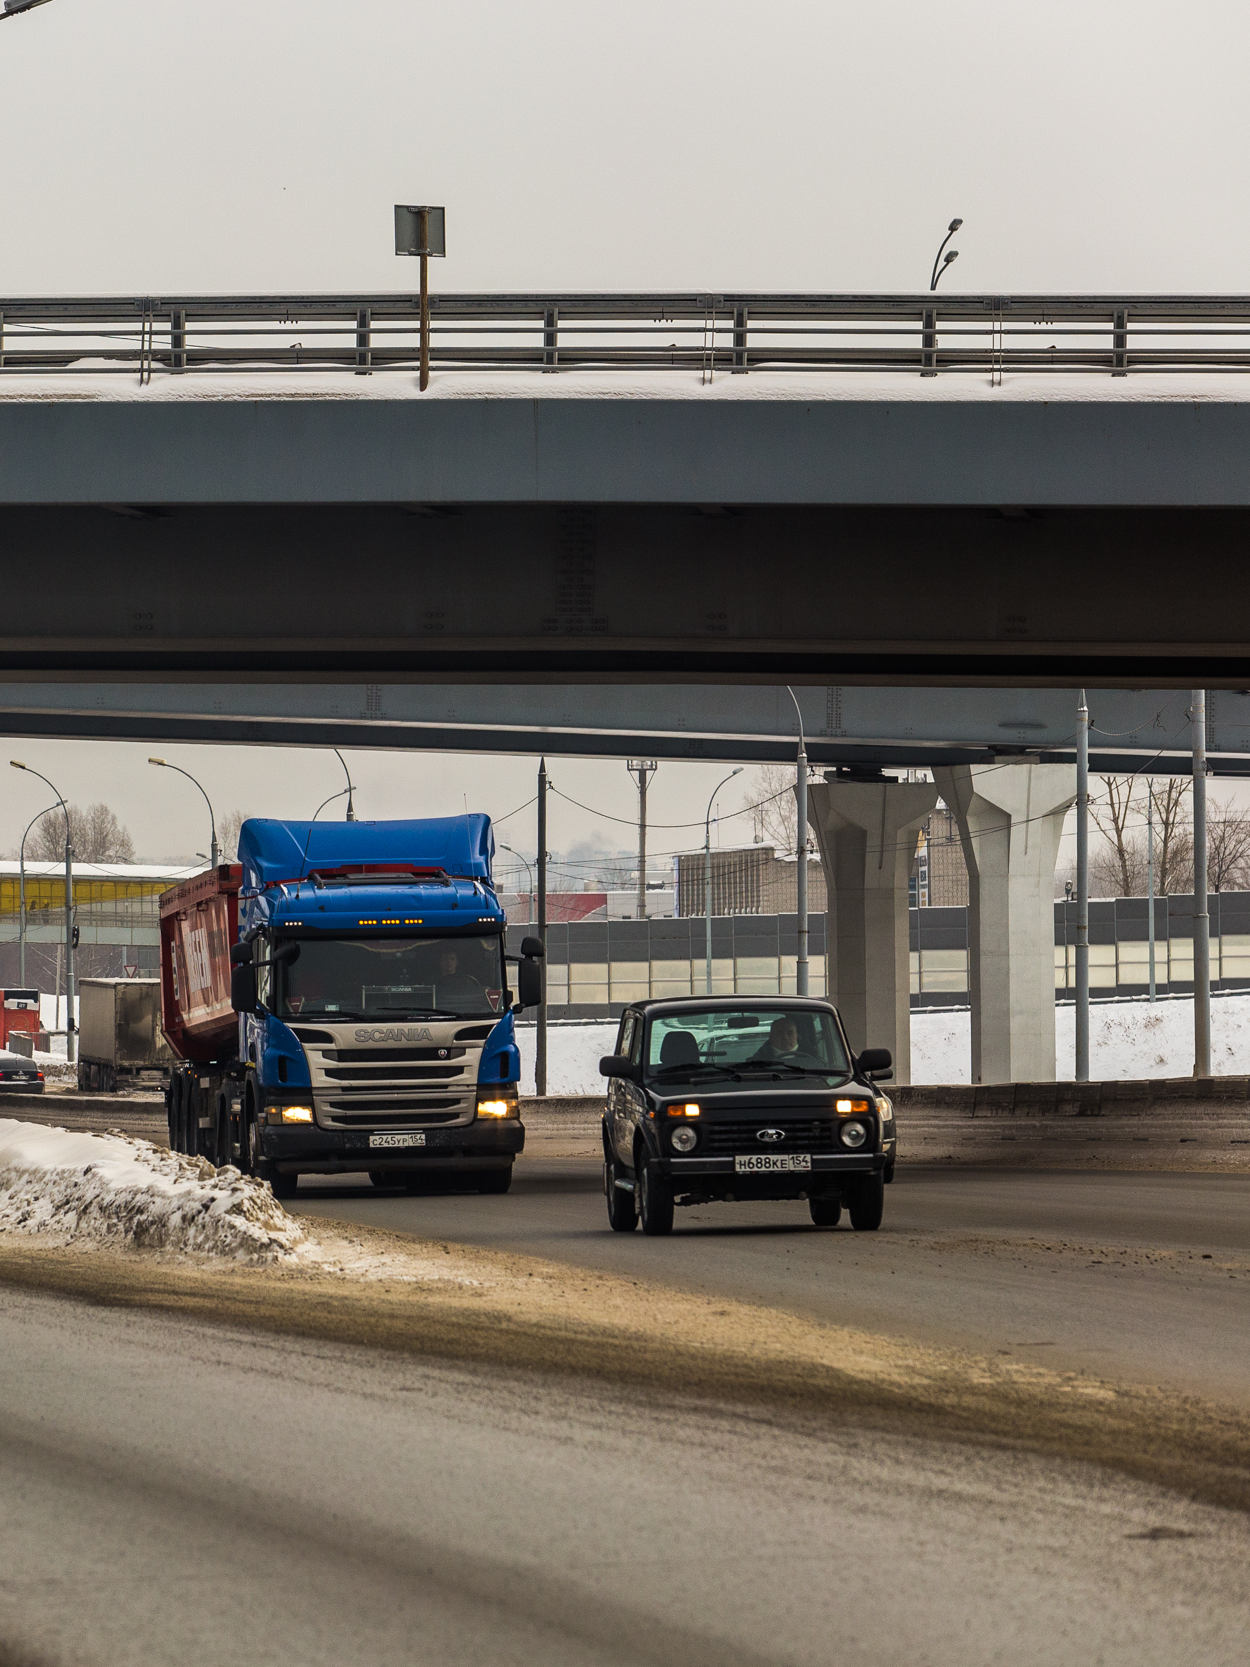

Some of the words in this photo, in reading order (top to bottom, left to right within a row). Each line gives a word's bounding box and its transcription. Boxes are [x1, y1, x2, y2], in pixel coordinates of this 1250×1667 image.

[354, 1028, 433, 1042] SCANIA
[372, 1136, 408, 1146] С245УР
[739, 1156, 788, 1170] Н688КЕ
[790, 1155, 810, 1165] 154
